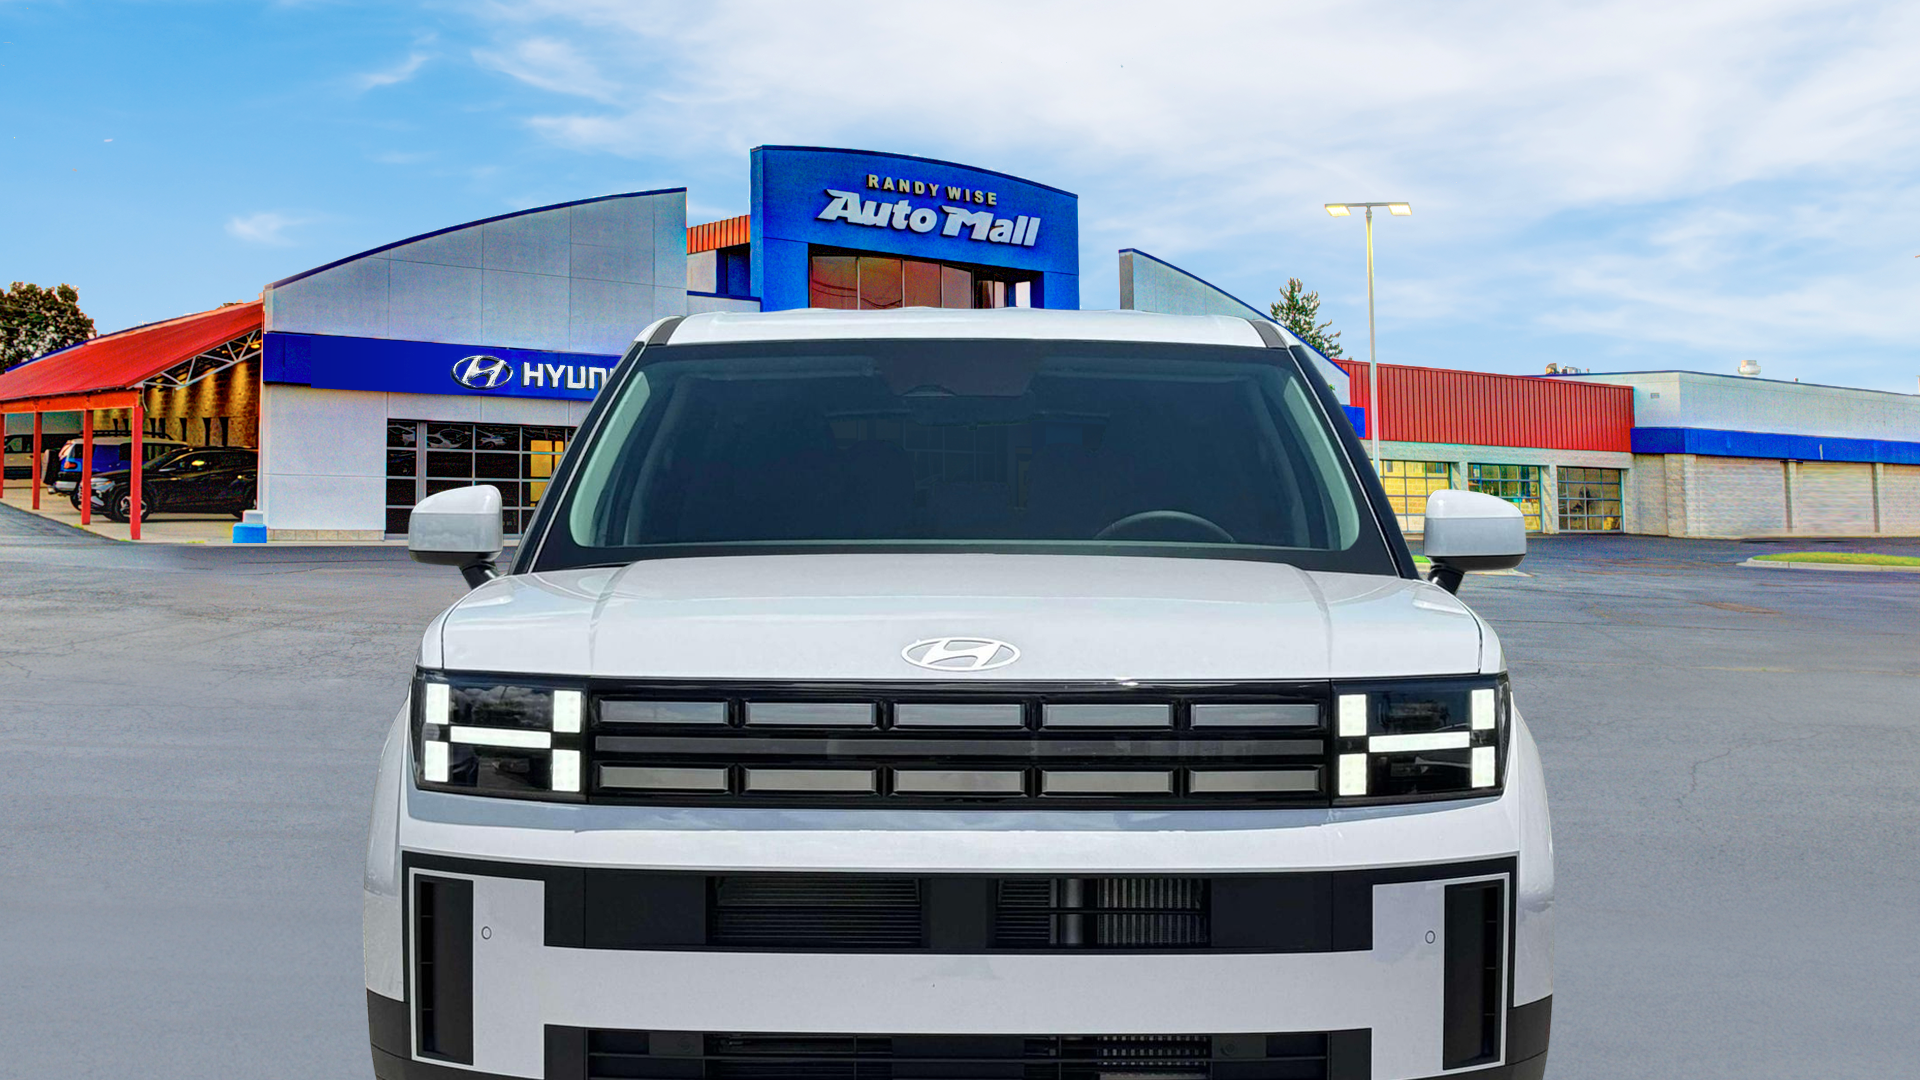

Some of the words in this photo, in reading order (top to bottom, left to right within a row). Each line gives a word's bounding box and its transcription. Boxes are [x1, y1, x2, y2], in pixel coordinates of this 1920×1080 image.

[867, 174, 939, 197] RANDY
[946, 186, 998, 206] WISE
[816, 188, 938, 233] Auto
[941, 205, 1041, 247] Mall
[522, 361, 616, 390] HYUN
